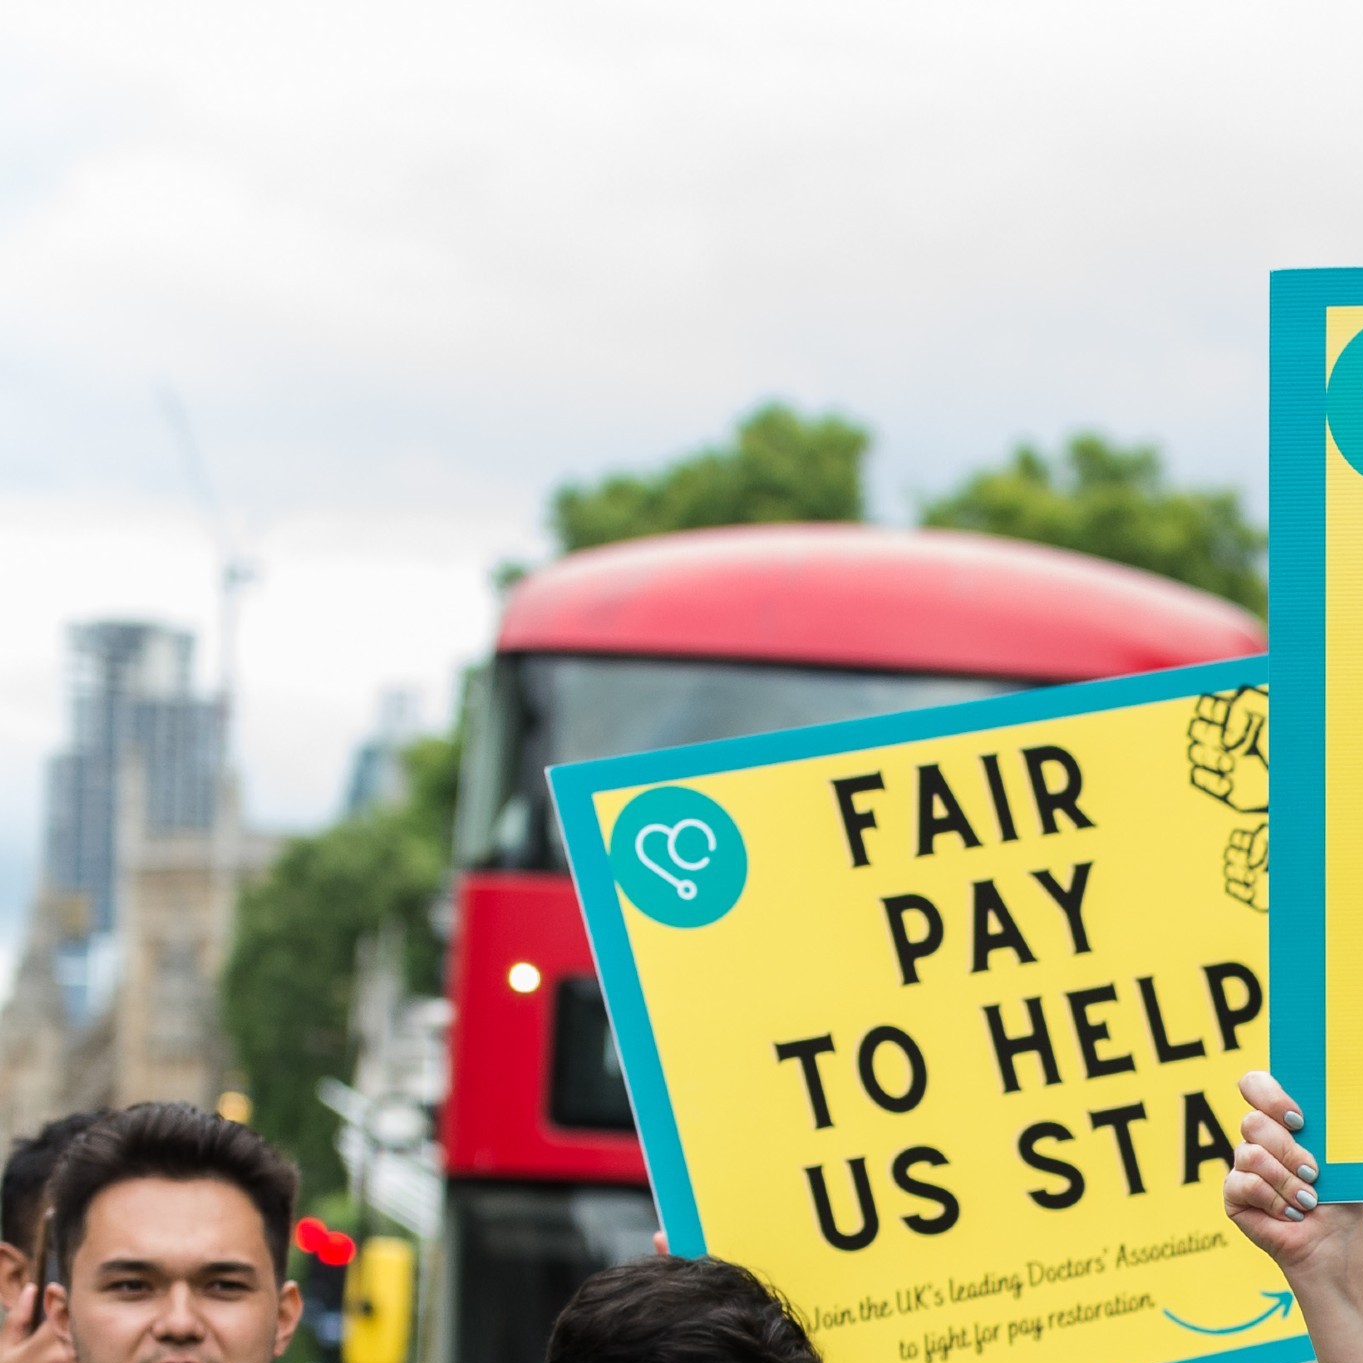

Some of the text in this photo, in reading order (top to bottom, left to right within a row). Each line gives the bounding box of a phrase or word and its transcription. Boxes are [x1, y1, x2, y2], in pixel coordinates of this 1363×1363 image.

[830, 745, 1097, 868] FAIR
[880, 861, 1095, 986] PAY
[773, 961, 1264, 1131] TO HELP
[803, 1091, 1236, 1251] US STA
[805, 1229, 1230, 1335] Join the UK's leading Doctors' Association
[899, 1338, 918, 1362] to
[974, 1320, 1003, 1354] for
[1007, 1318, 1045, 1346] pay
[1047, 1292, 1157, 1330] restoration
